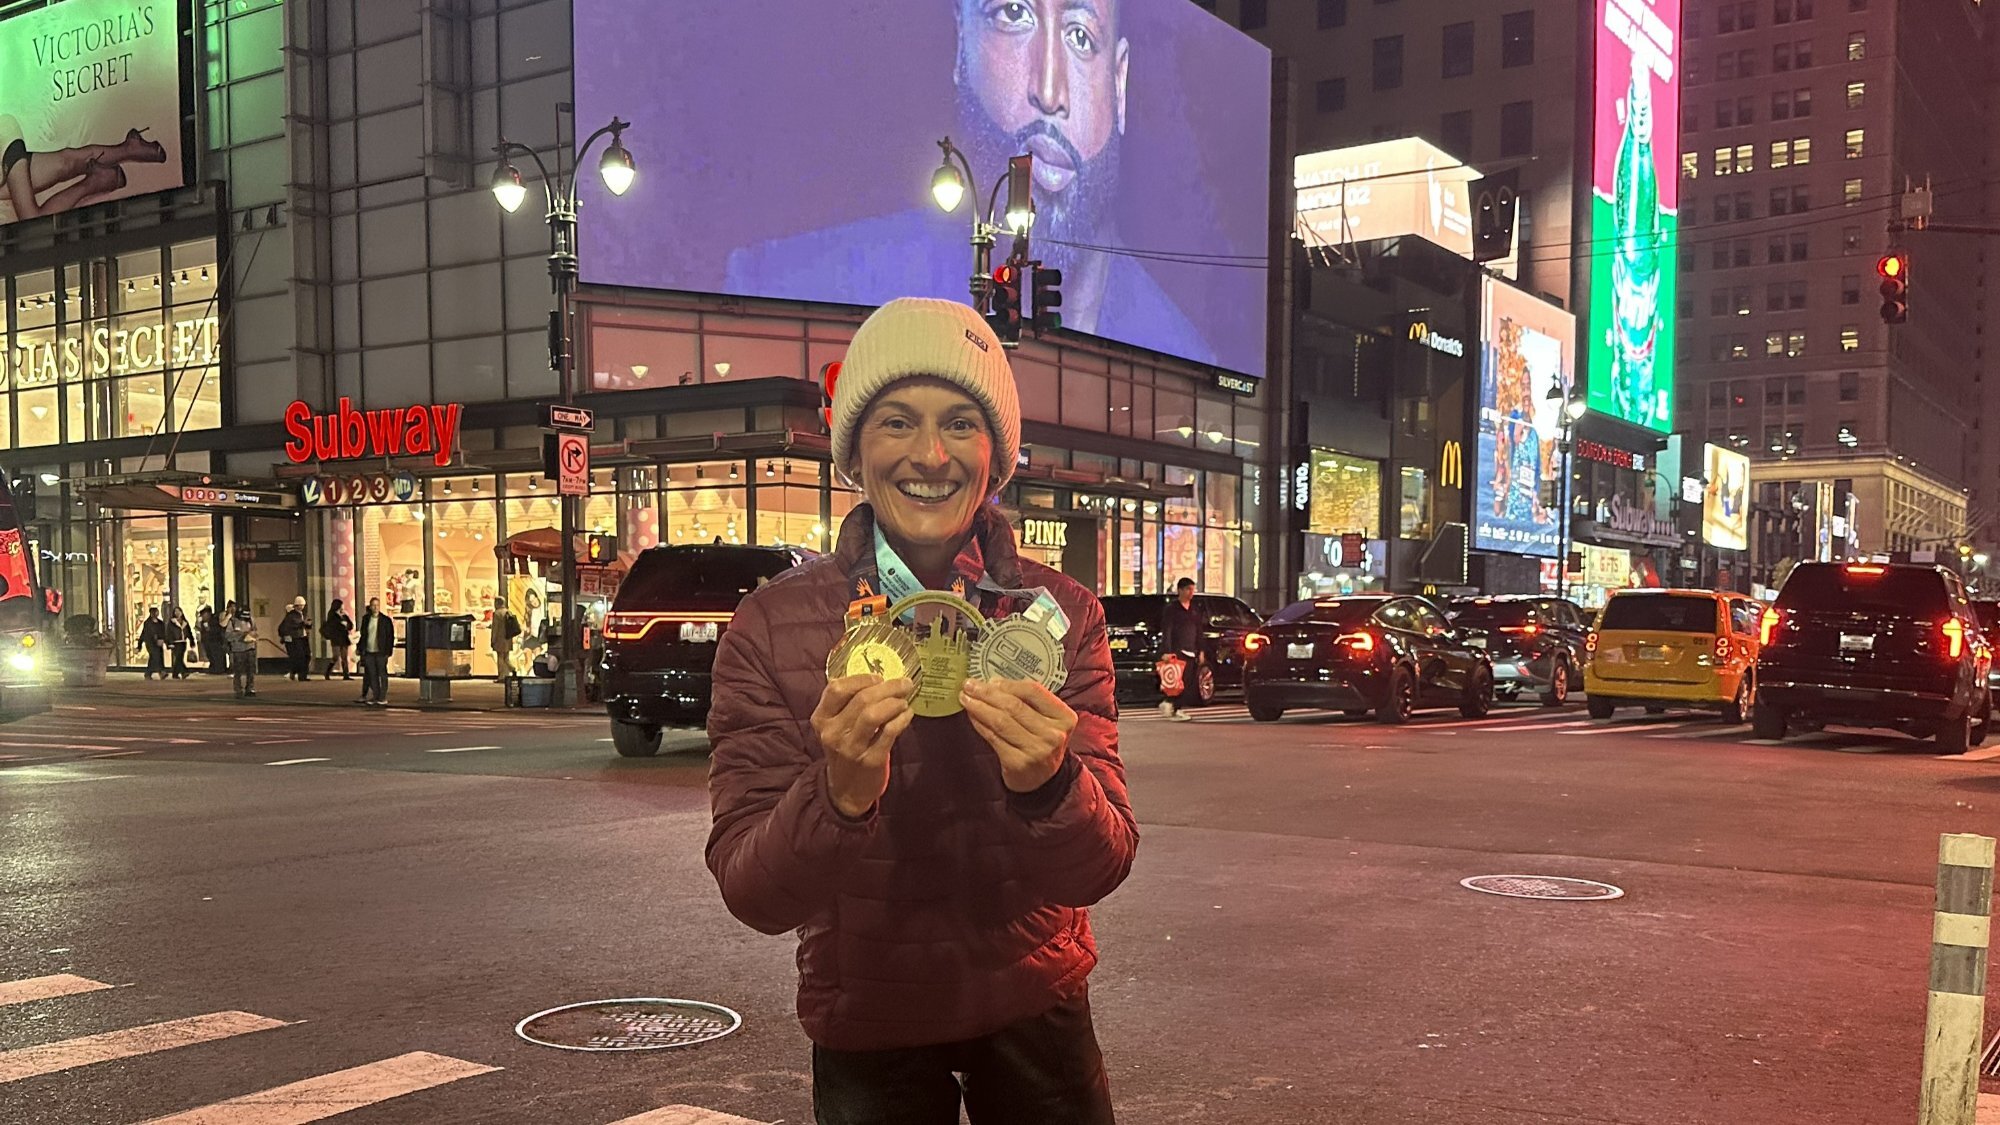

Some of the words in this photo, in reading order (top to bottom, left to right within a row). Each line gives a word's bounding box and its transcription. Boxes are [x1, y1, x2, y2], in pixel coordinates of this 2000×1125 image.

[32, 6, 154, 67] VICTORIA'S
[53, 53, 133, 101] SECRET
[967, 331, 987, 350] FILA
[557, 413, 569, 421] ONE
[575, 415, 587, 423] WAY
[286, 397, 458, 467] Subway
[234, 493, 260, 504] Subway
[329, 481, 337, 500] 1
[353, 479, 364, 499] 2
[375, 477, 386, 498] 3
[1024, 519, 1068, 546] PINK
